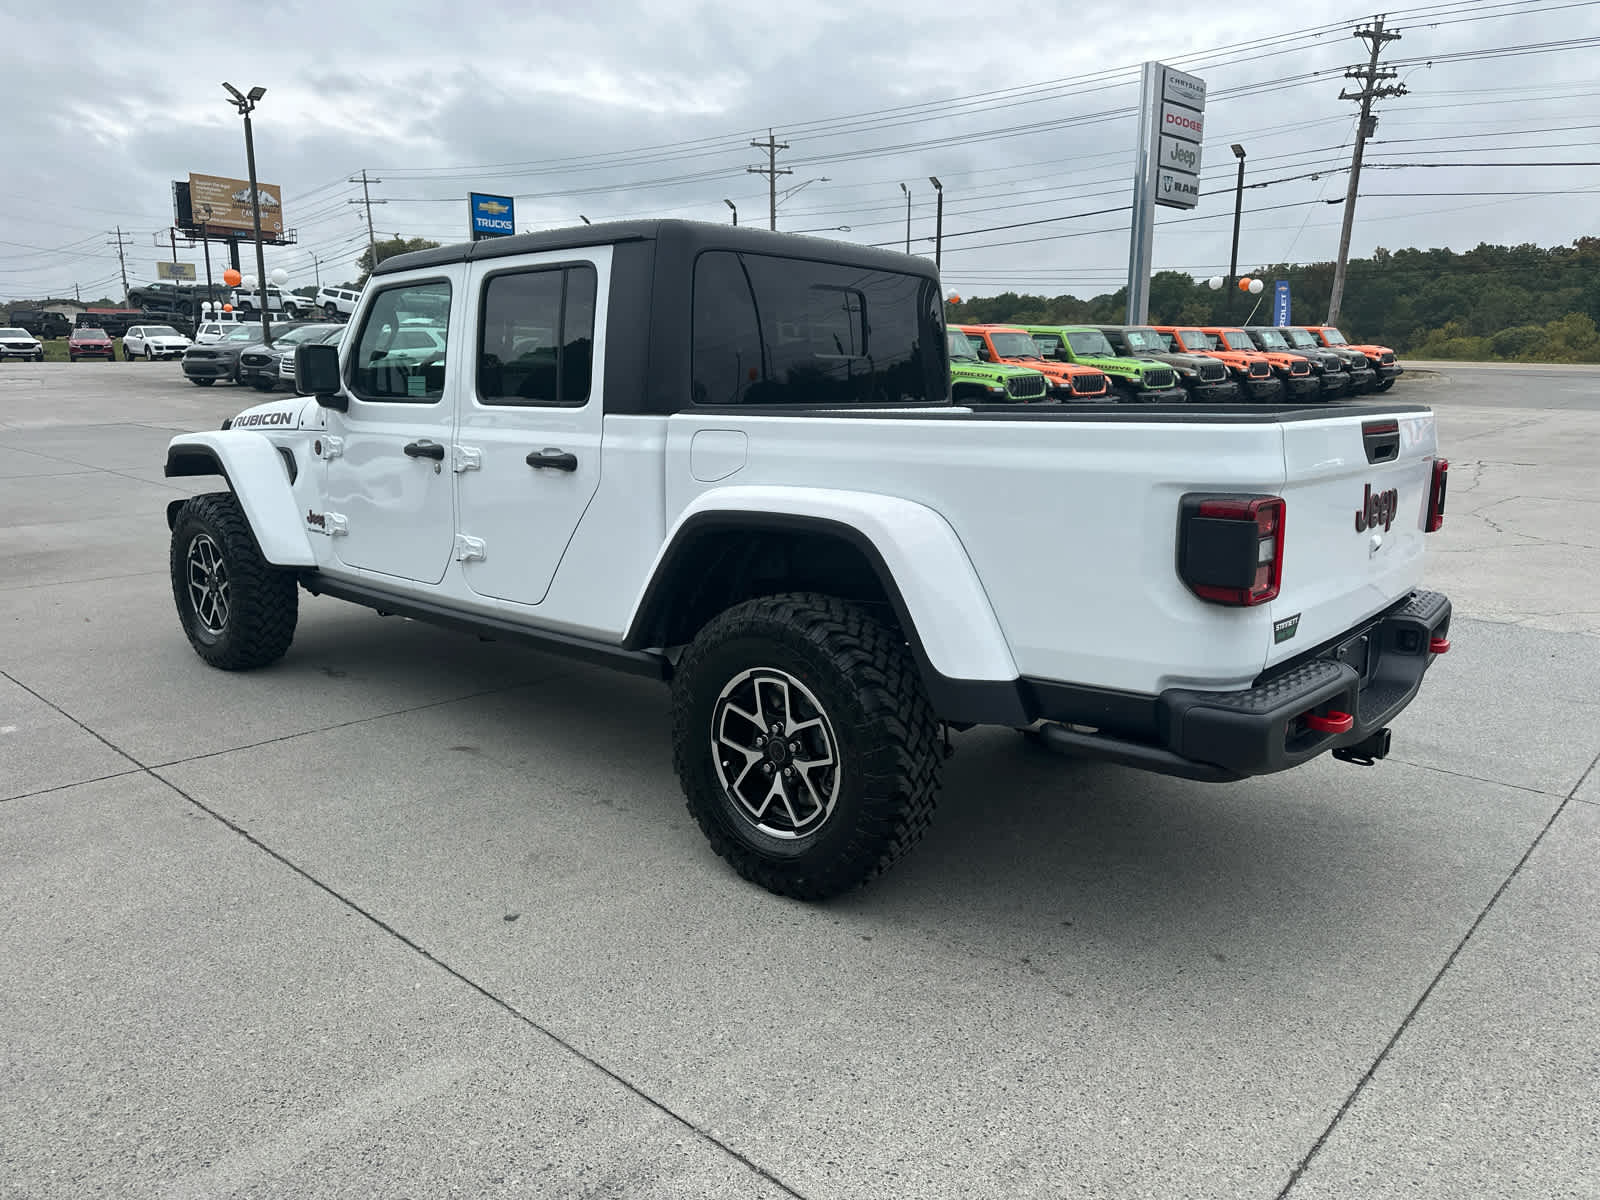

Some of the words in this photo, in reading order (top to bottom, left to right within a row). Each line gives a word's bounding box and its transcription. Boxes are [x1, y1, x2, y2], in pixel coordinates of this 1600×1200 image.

[1169, 77, 1204, 93] CHRYSLER
[1166, 113, 1202, 133] DODGE
[1171, 142, 1196, 169] Jeep
[1174, 181, 1198, 196] RAM
[475, 217, 513, 230] TRUCKS
[950, 370, 993, 378] UBICON
[233, 412, 293, 428] RUBICON
[1355, 483, 1398, 533] Jeep
[306, 509, 326, 529] Jeep
